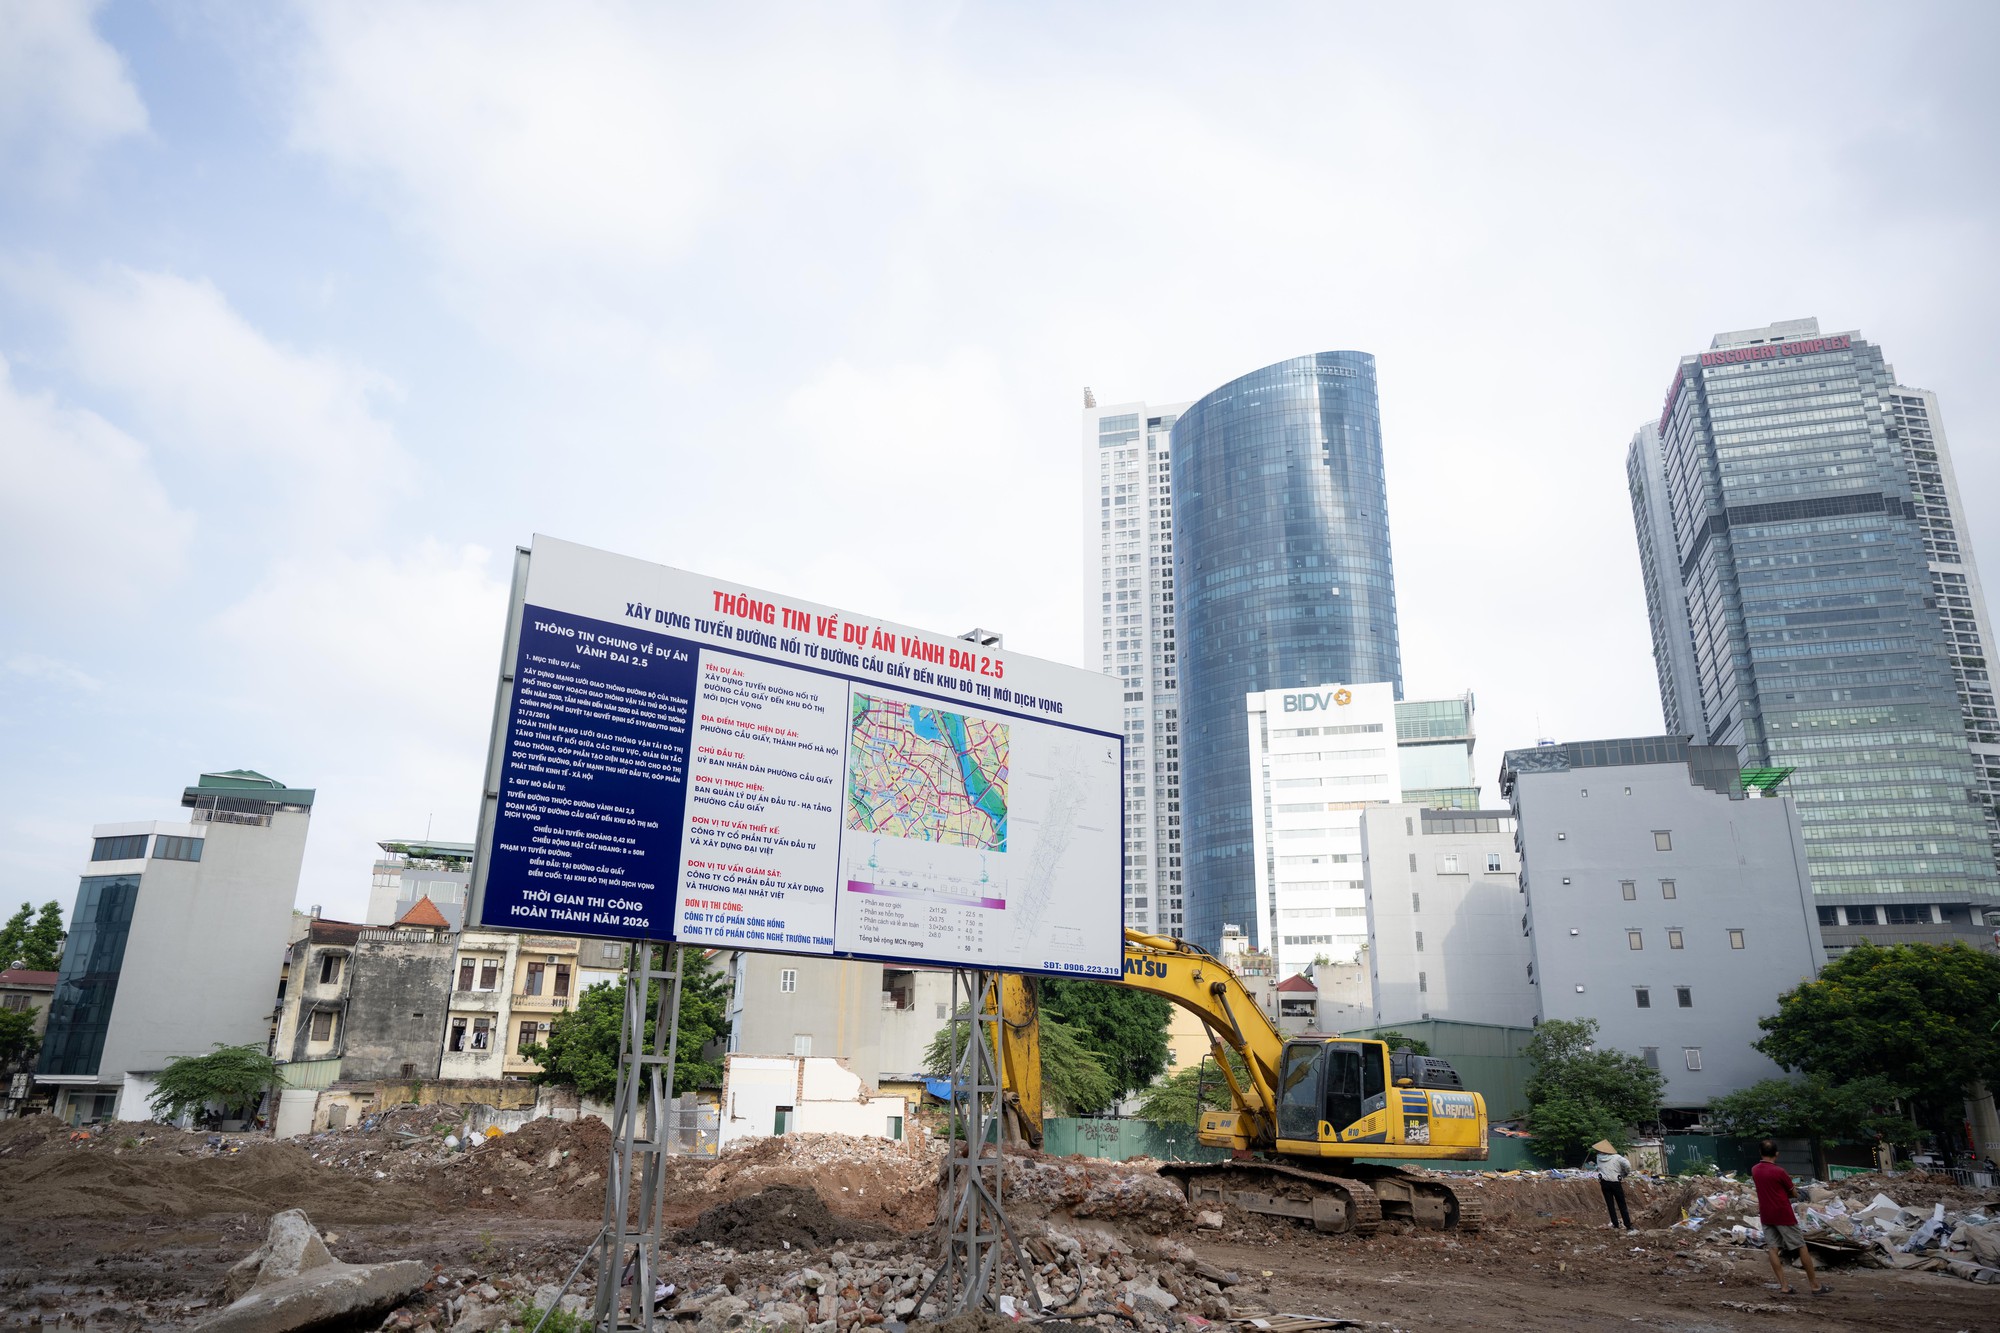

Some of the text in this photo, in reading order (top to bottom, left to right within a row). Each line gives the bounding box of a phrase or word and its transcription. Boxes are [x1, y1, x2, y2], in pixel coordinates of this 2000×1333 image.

[1701, 335, 1850, 367] DISCOVERY COMPLEX
[534, 621, 688, 662] THÔNG TIN CHUNG VỀ DỰ ÁN
[714, 590, 1004, 679] THÔNG TIN VỀ DỰ ÁN VÀNH ĐAI 2.5
[532, 655, 547, 664] MỤC
[547, 658, 560, 666] TIÊU
[560, 660, 570, 669] DỰ
[570, 661, 581, 670] ÁN:
[576, 644, 648, 667] VÀNH ĐAI 2.5
[625, 602, 1063, 714] XÂY DỰNG TUYẾN ĐƯỜNG NỐI TỪ ĐƯỜNG CẦU GIẤY ĐẾN KHU ĐÔ THỊ MỚI DỊCH VỌNG
[705, 663, 744, 678] TÊN DỰ ÁN:
[704, 672, 819, 702] XÂY DỰNG TUYẾN ĐƯỜNG NỐI TỪ
[704, 682, 825, 713] ĐƯỜNG CẦU GIẤY ĐẾN KHU ĐÔ THỊ
[703, 692, 762, 710] MỚI DỊCH VỌNG
[1284, 692, 1333, 712] BIDV
[518, 708, 550, 720] 31/3/2016
[701, 714, 798, 738] ĐỊA ĐIỂM THỰC HIỆN DỰ ÁN:
[700, 724, 839, 756] PHƯỜNG CẦU GIẤY, THÀNH PHỐ HÀ NỘI
[698, 745, 745, 760] CHỦ ĐẦU TƯ:
[697, 756, 833, 785] UỶ BAN NHÂN DÂN PHƯỜNG CẦU GIẤY
[523, 889, 643, 912] THỜI GIAN THI CÔNG
[685, 898, 744, 912] ĐƠN VỊ THI CÔNG:
[510, 905, 649, 928] HOÀN THÀNH NĂM 2026
[684, 910, 704, 922] CÔNG
[705, 913, 714, 922] TY
[746, 917, 766, 927] SÔNG
[683, 925, 703, 935] CÔNG
[704, 926, 713, 936] TY
[746, 930, 765, 940] CÔNG
[766, 932, 784, 943] NGHỆ
[785, 934, 811, 944] TRƯỜNG
[812, 936, 834, 946] THÀNH
[1043, 961, 1119, 975] SĐT: 0906.223.319
[1124, 955, 1167, 978] ATSU
[1445, 1104, 1474, 1117] RENTAL
